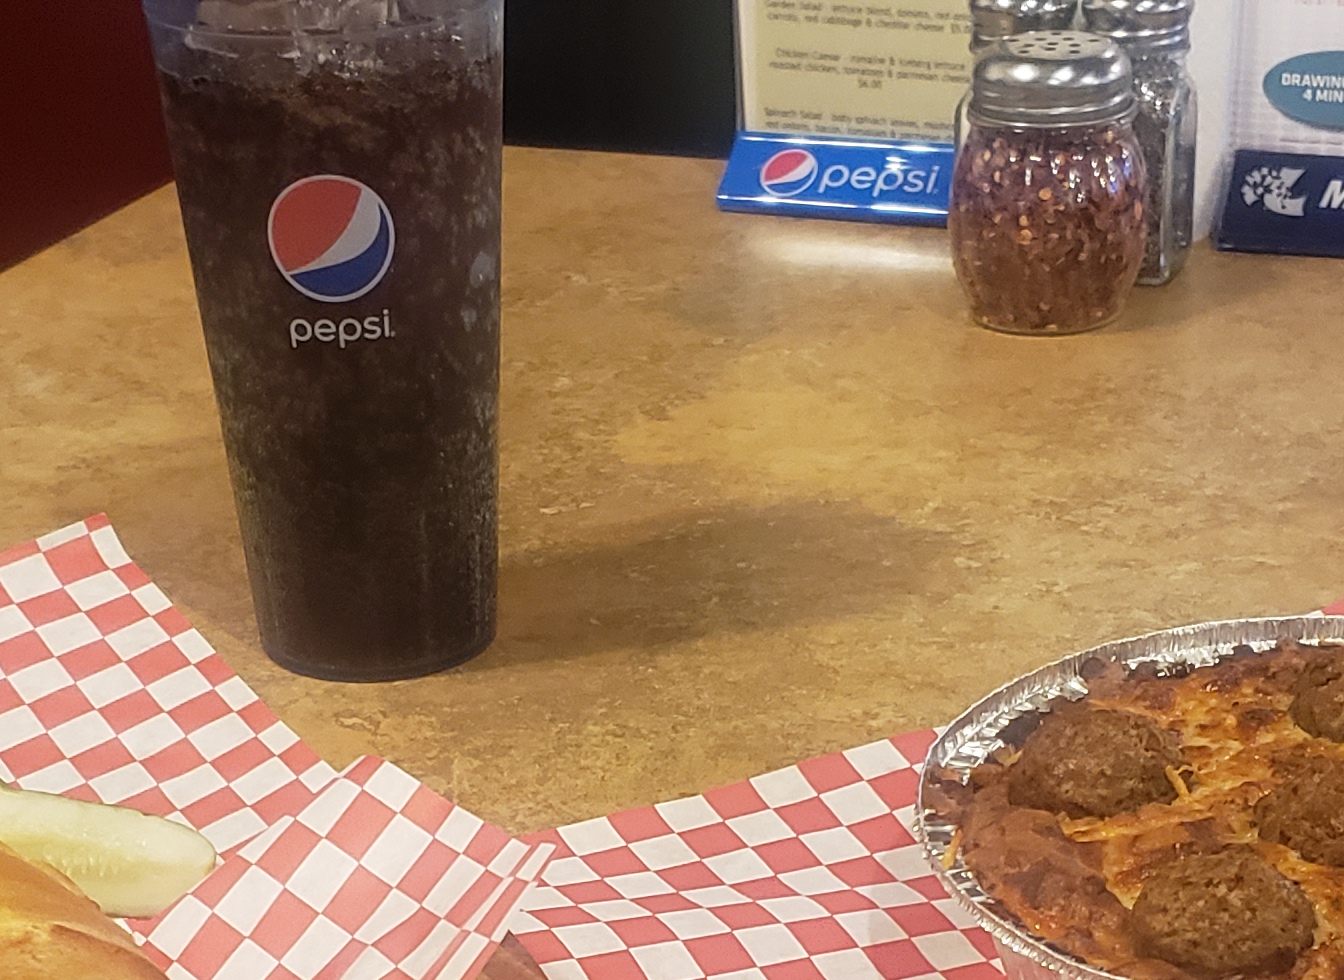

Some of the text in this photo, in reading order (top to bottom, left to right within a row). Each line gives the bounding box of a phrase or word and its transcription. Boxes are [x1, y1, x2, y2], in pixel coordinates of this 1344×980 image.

[1303, 90, 1312, 102] 4
[818, 164, 941, 198] pepsi
[289, 309, 392, 348] pepsi
